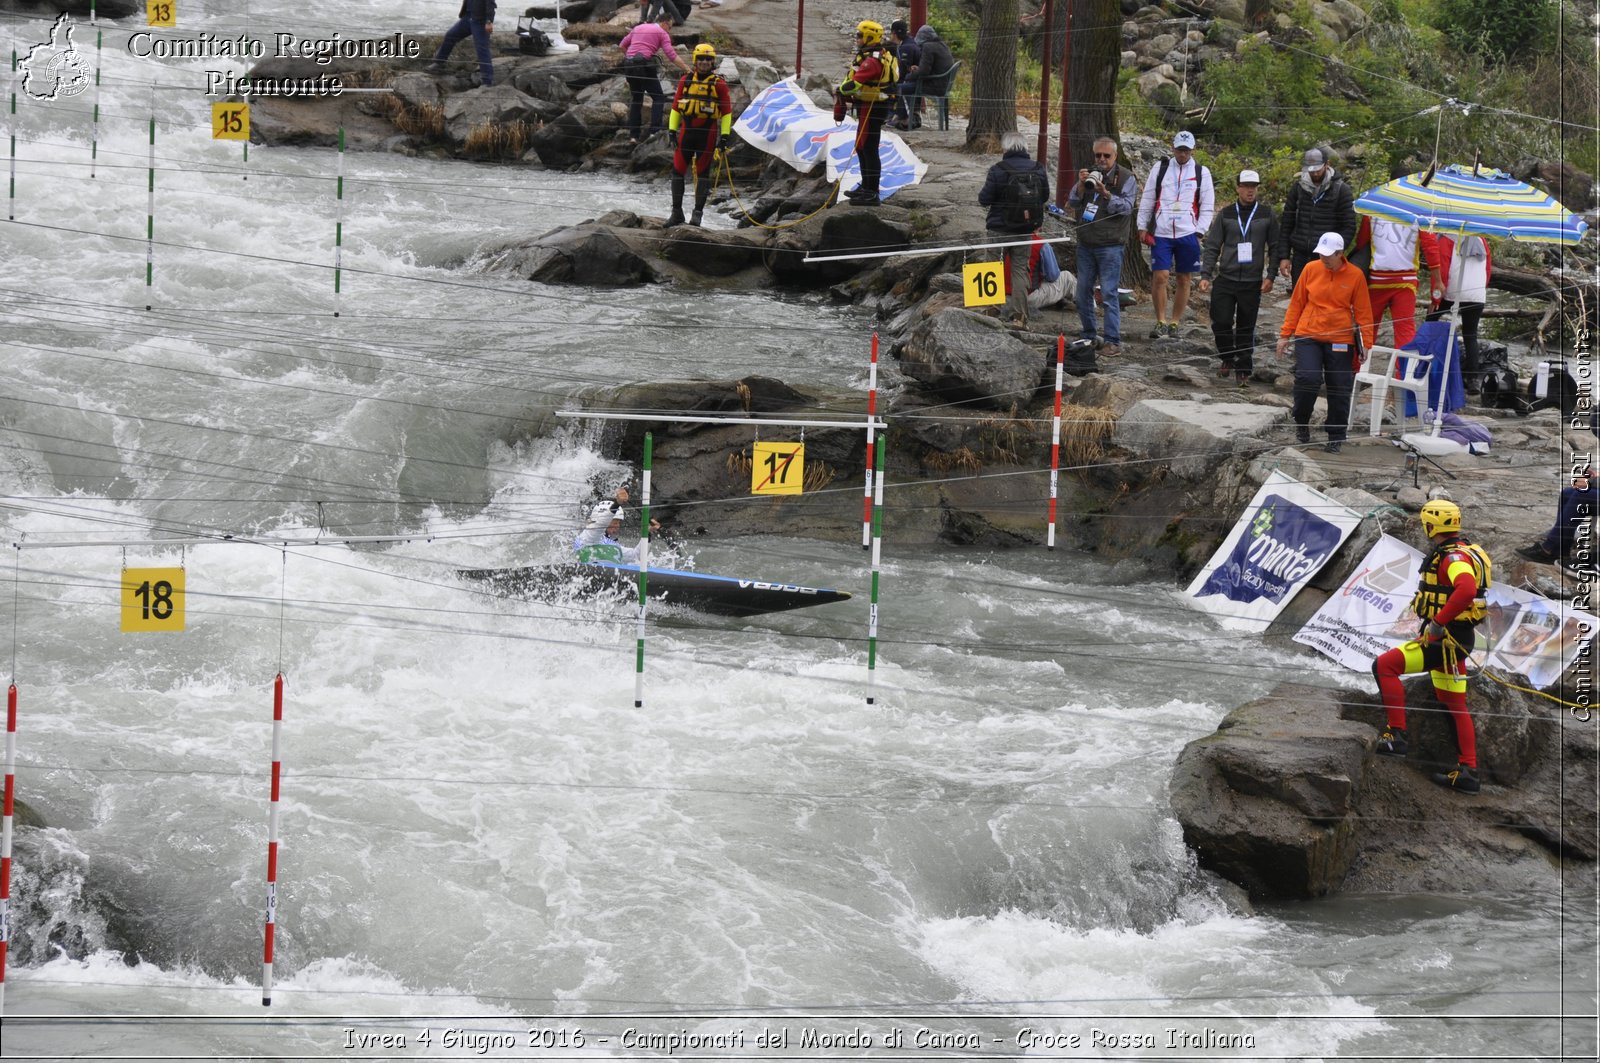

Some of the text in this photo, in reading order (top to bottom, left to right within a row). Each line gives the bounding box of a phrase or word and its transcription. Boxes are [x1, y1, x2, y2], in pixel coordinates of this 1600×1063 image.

[153, 4, 171, 22] 13
[219, 110, 243, 133] 15
[972, 271, 998, 298] 16
[764, 453, 795, 485] 17
[134, 580, 174, 620] 18
